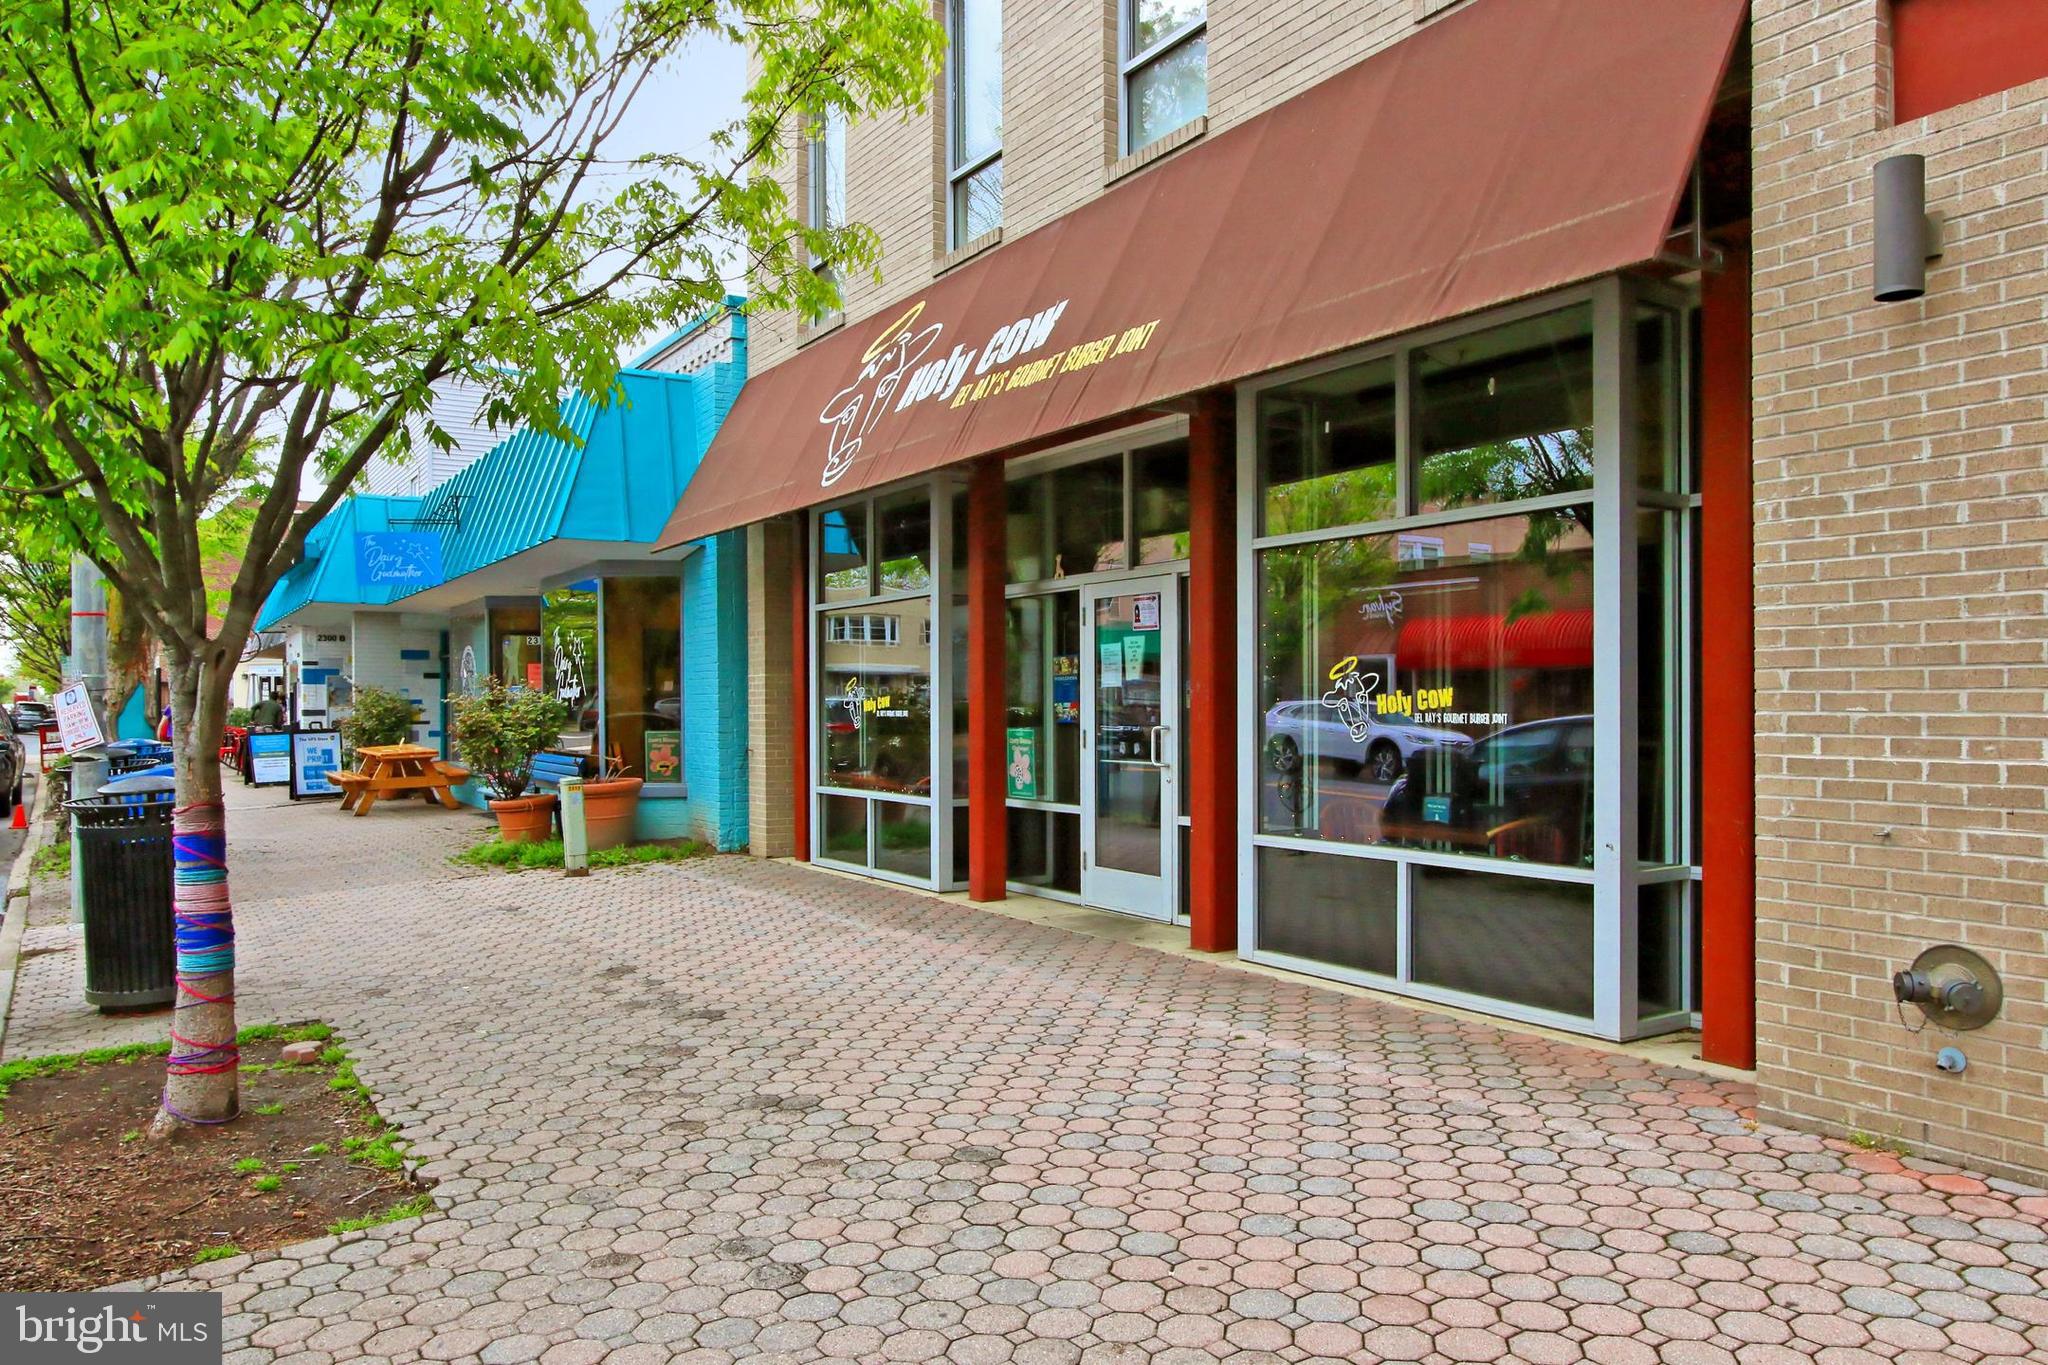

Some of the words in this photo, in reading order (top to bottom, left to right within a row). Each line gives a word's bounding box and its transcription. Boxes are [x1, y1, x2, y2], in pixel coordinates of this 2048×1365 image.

[1005, 351, 1066, 392] GOURMET
[1060, 334, 1117, 374] BURGER
[1110, 319, 1160, 359] JOINT
[365, 545, 402, 567] Dairy
[317, 634, 337, 642] 2300
[1443, 712, 1468, 724] GOURMET
[1469, 712, 1490, 725] BURGER
[1491, 713, 1508, 725] JOINT
[307, 746, 318, 754] WE
